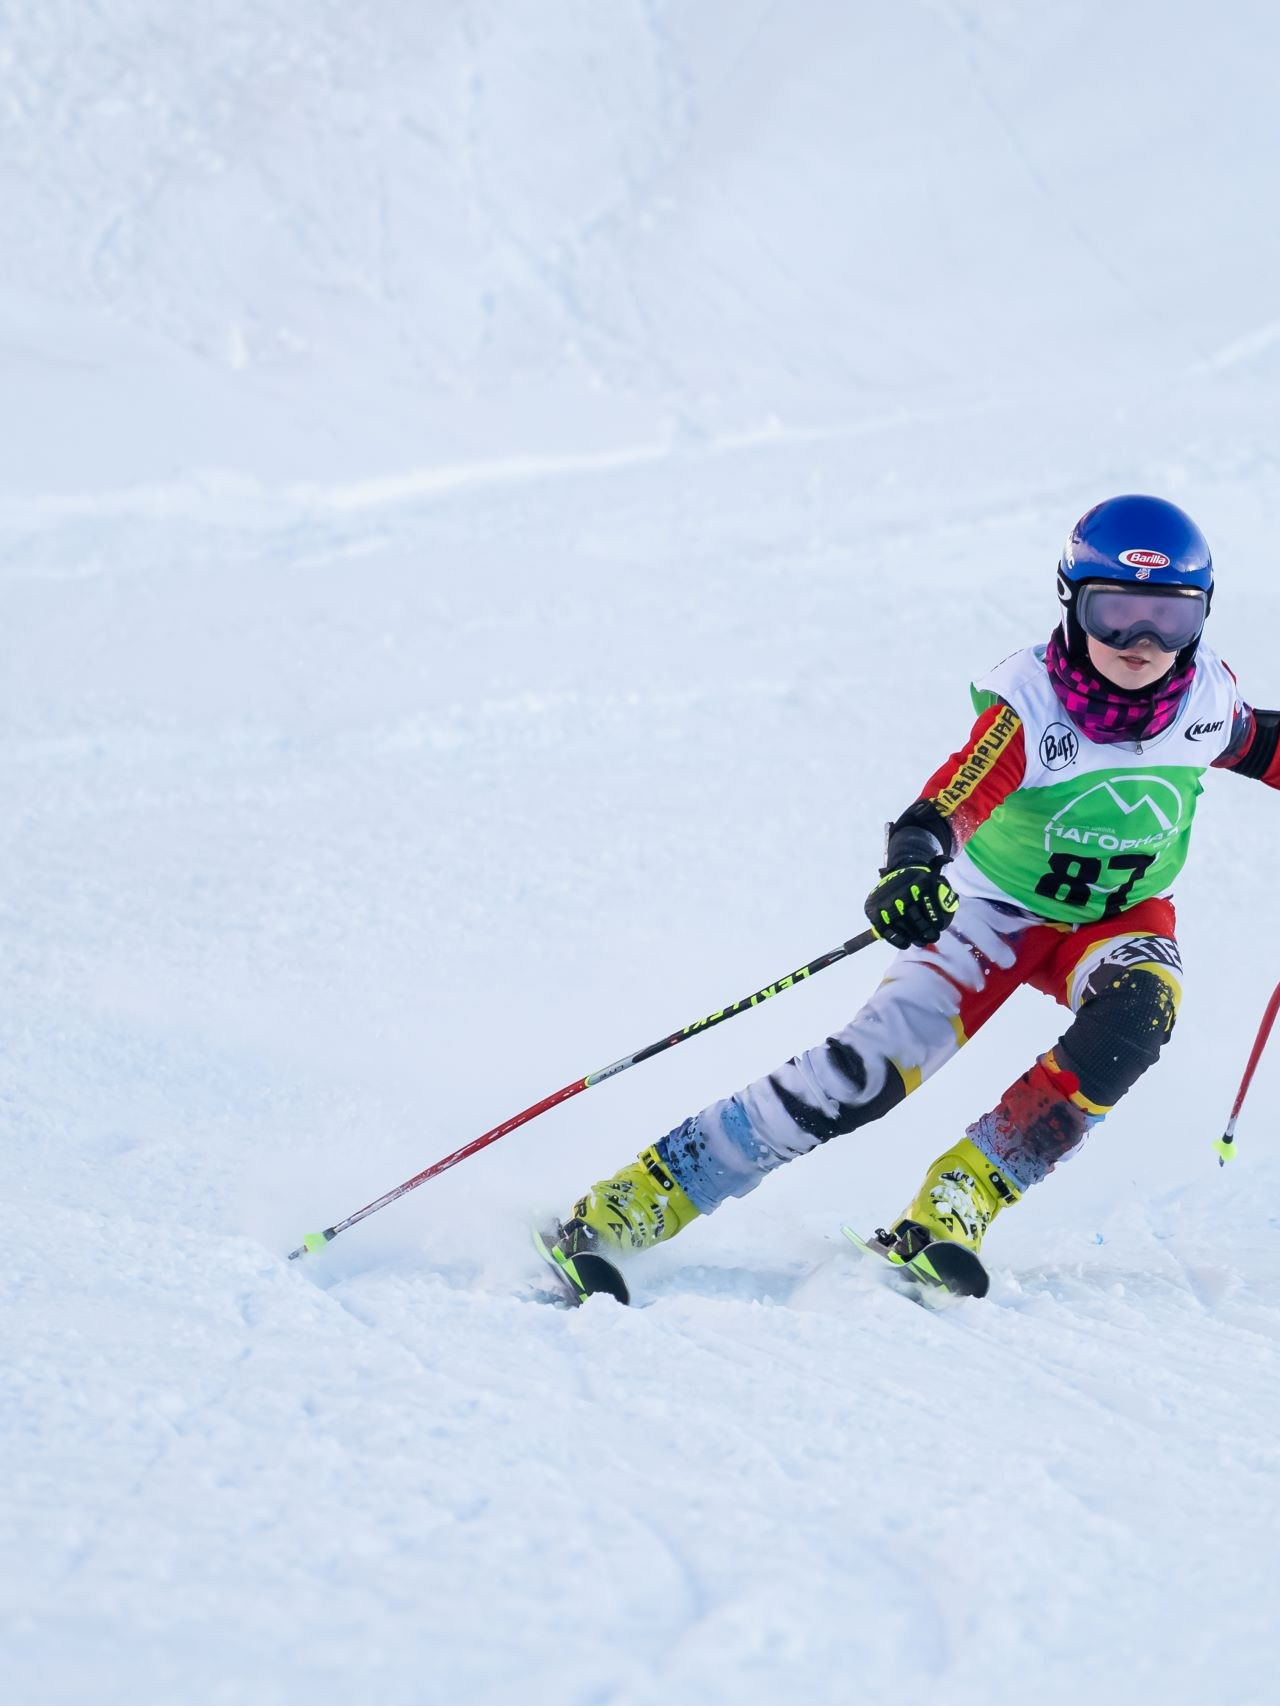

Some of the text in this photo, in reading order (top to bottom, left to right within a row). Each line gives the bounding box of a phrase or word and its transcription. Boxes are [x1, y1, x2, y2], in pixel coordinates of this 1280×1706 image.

[1130, 553, 1166, 565] Barilla
[1034, 852, 1157, 919] 87
[923, 896, 938, 921] LEKI
[750, 966, 810, 1007] LEKI
